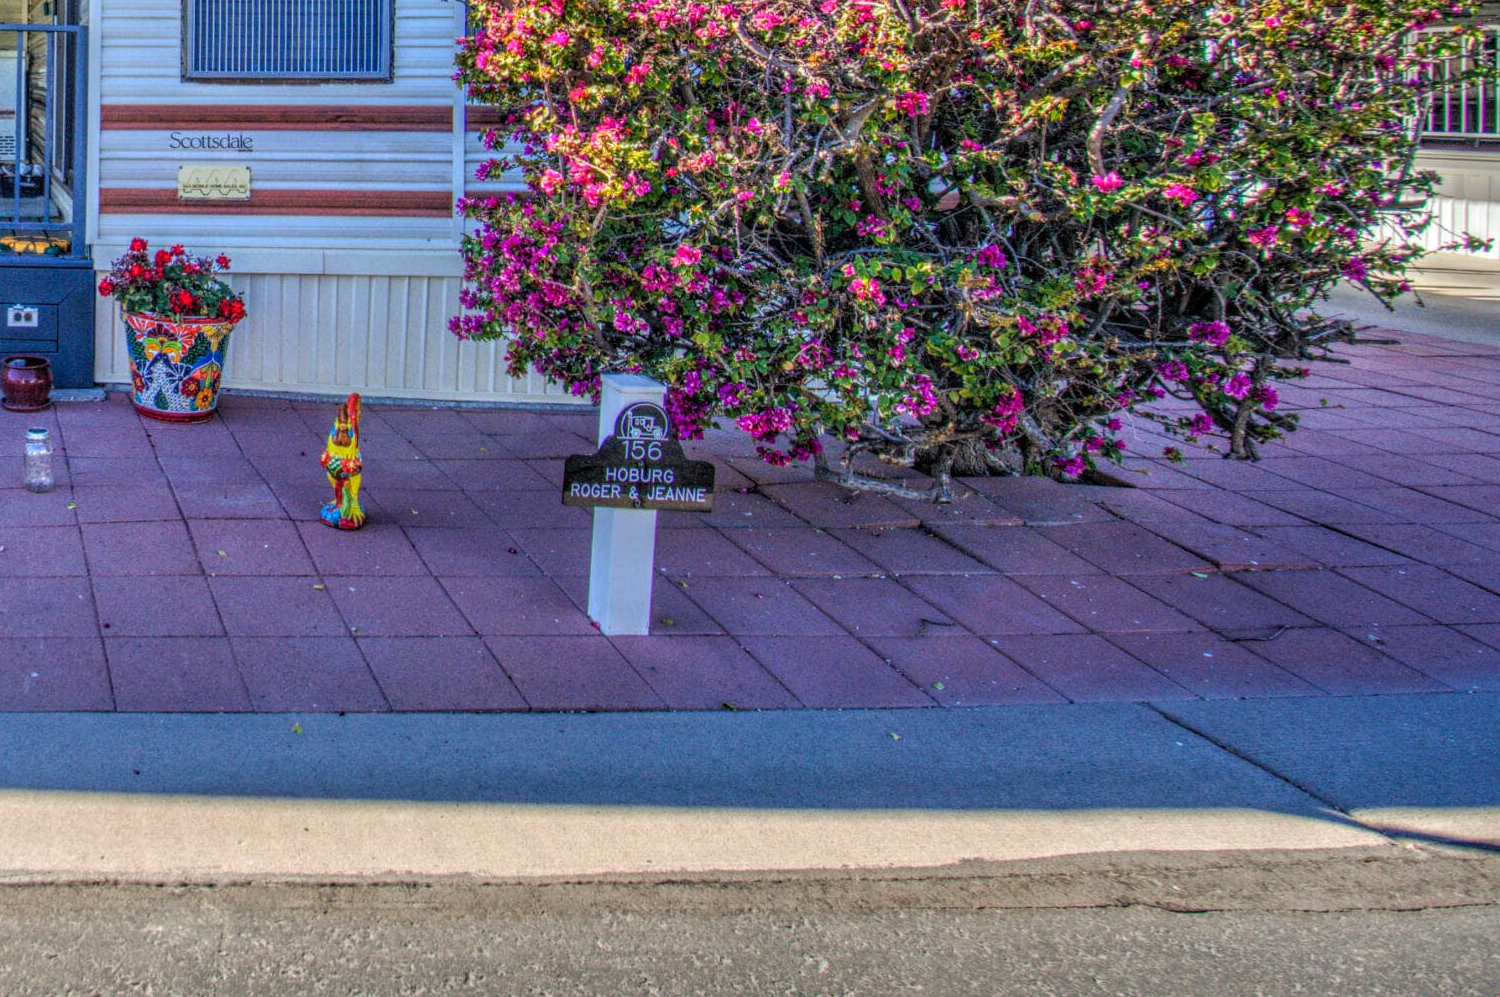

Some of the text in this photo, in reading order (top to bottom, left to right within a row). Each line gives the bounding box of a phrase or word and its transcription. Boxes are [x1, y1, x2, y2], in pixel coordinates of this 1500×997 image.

[169, 131, 253, 150] Scottsdale
[621, 440, 663, 461] 156
[605, 467, 675, 484] HOBURG
[570, 483, 707, 502] ROGER & JEANNE
